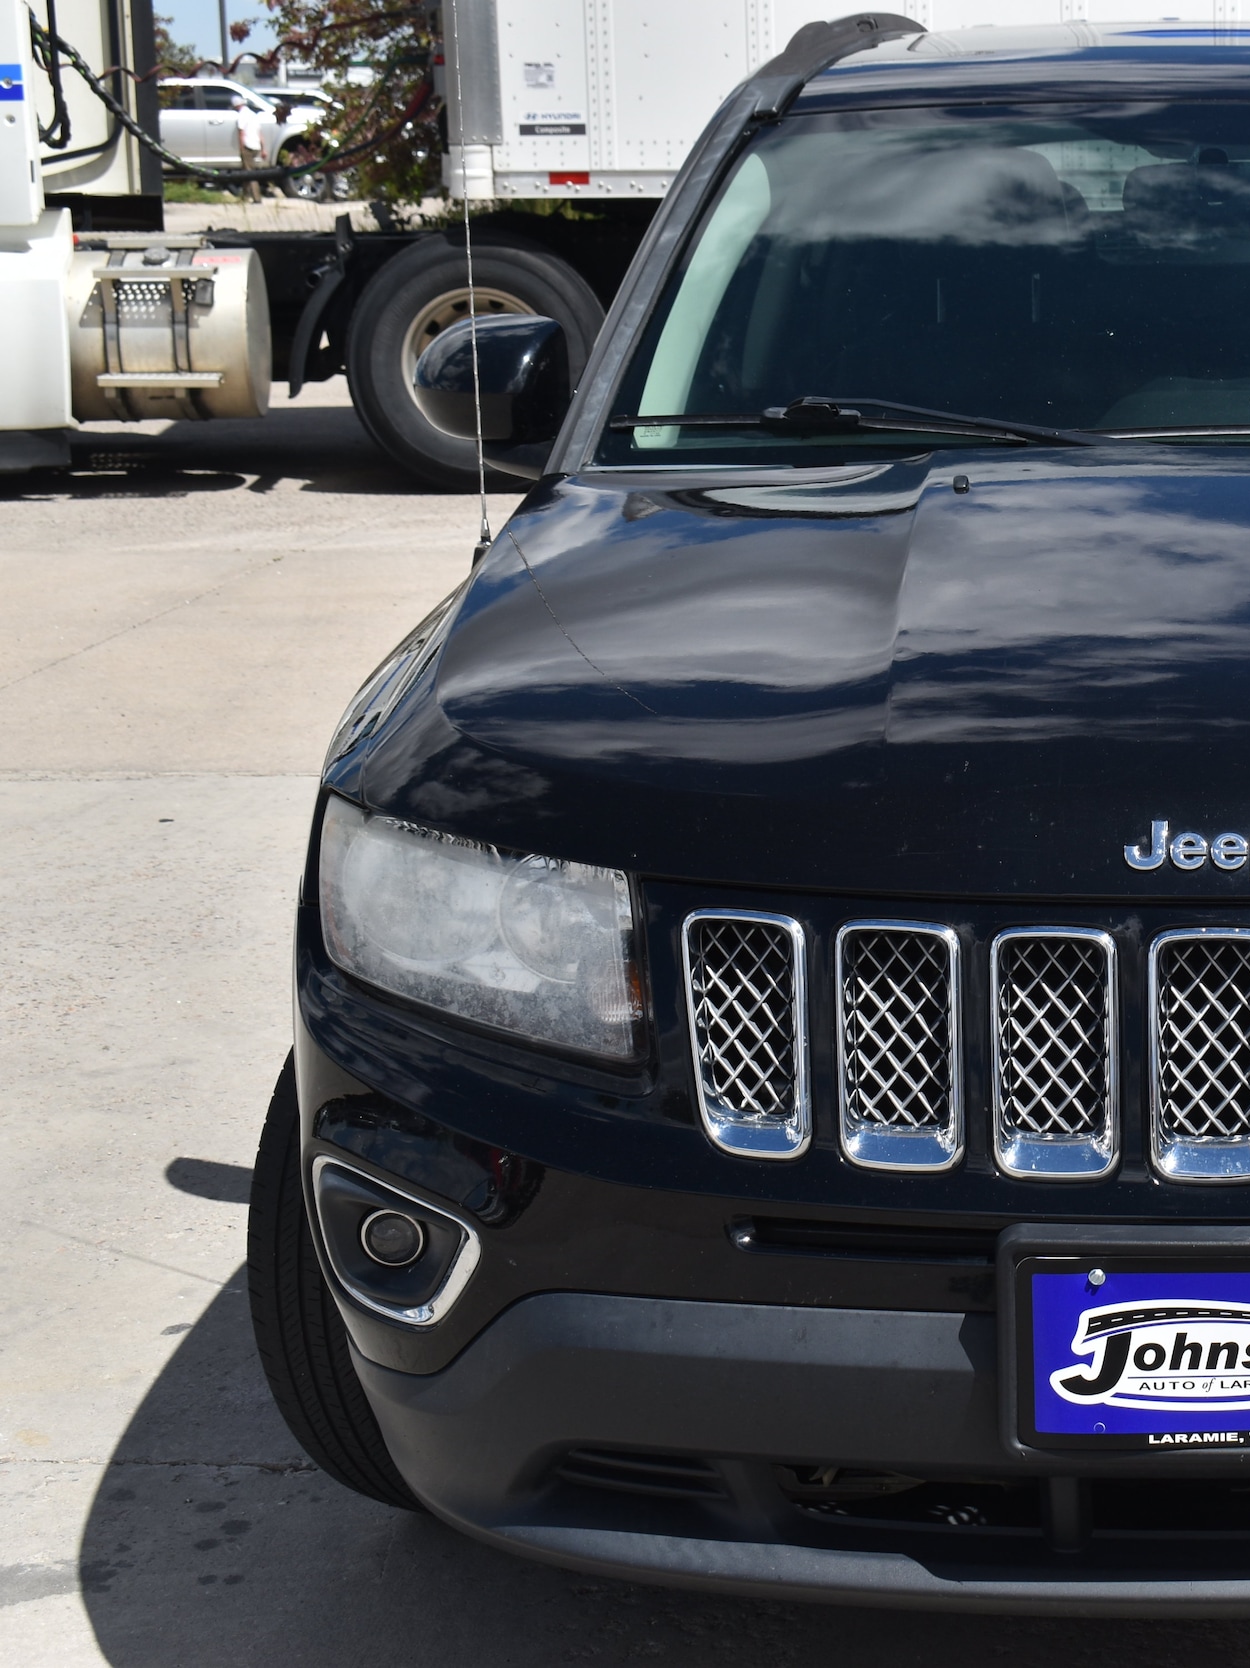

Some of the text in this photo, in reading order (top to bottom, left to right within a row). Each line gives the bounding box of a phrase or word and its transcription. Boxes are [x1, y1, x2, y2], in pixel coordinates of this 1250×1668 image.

[541, 112, 581, 121] HYUNDAI
[535, 126, 571, 135] Composite
[1138, 1381, 1196, 1391] AUTO
[1202, 1377, 1217, 1393] of
[1148, 1432, 1244, 1444] LARAMIE,
